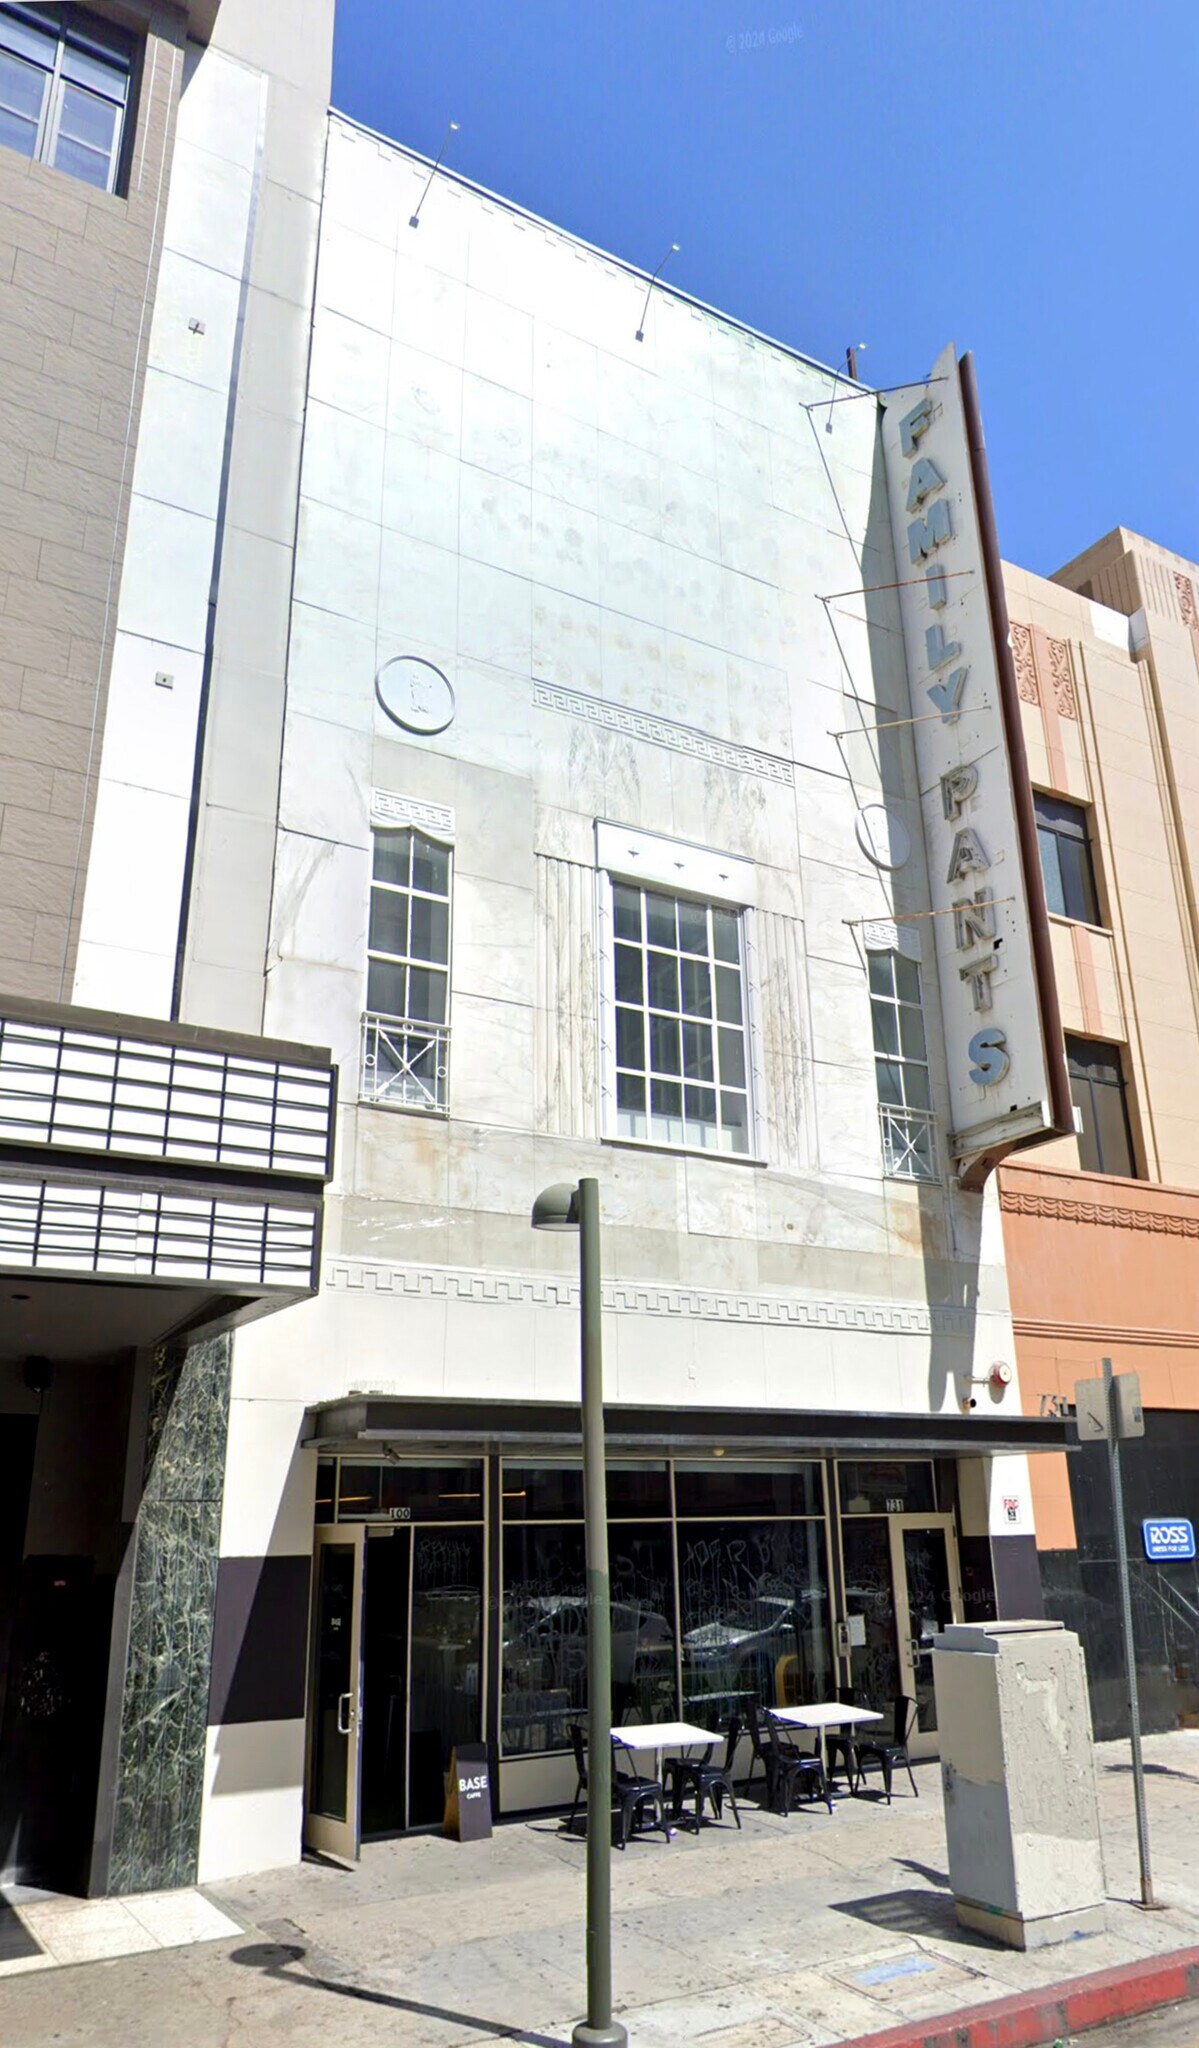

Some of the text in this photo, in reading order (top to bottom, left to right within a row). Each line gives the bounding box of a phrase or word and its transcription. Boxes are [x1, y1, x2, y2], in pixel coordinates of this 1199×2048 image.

[899, 399, 1011, 1086] FAMILY PANTS
[1036, 1393, 1070, 1417] 731
[391, 1508, 410, 1519] 100
[886, 1499, 904, 1512] 731
[1149, 1526, 1189, 1544] ROSS
[459, 1775, 488, 1792] BASE
